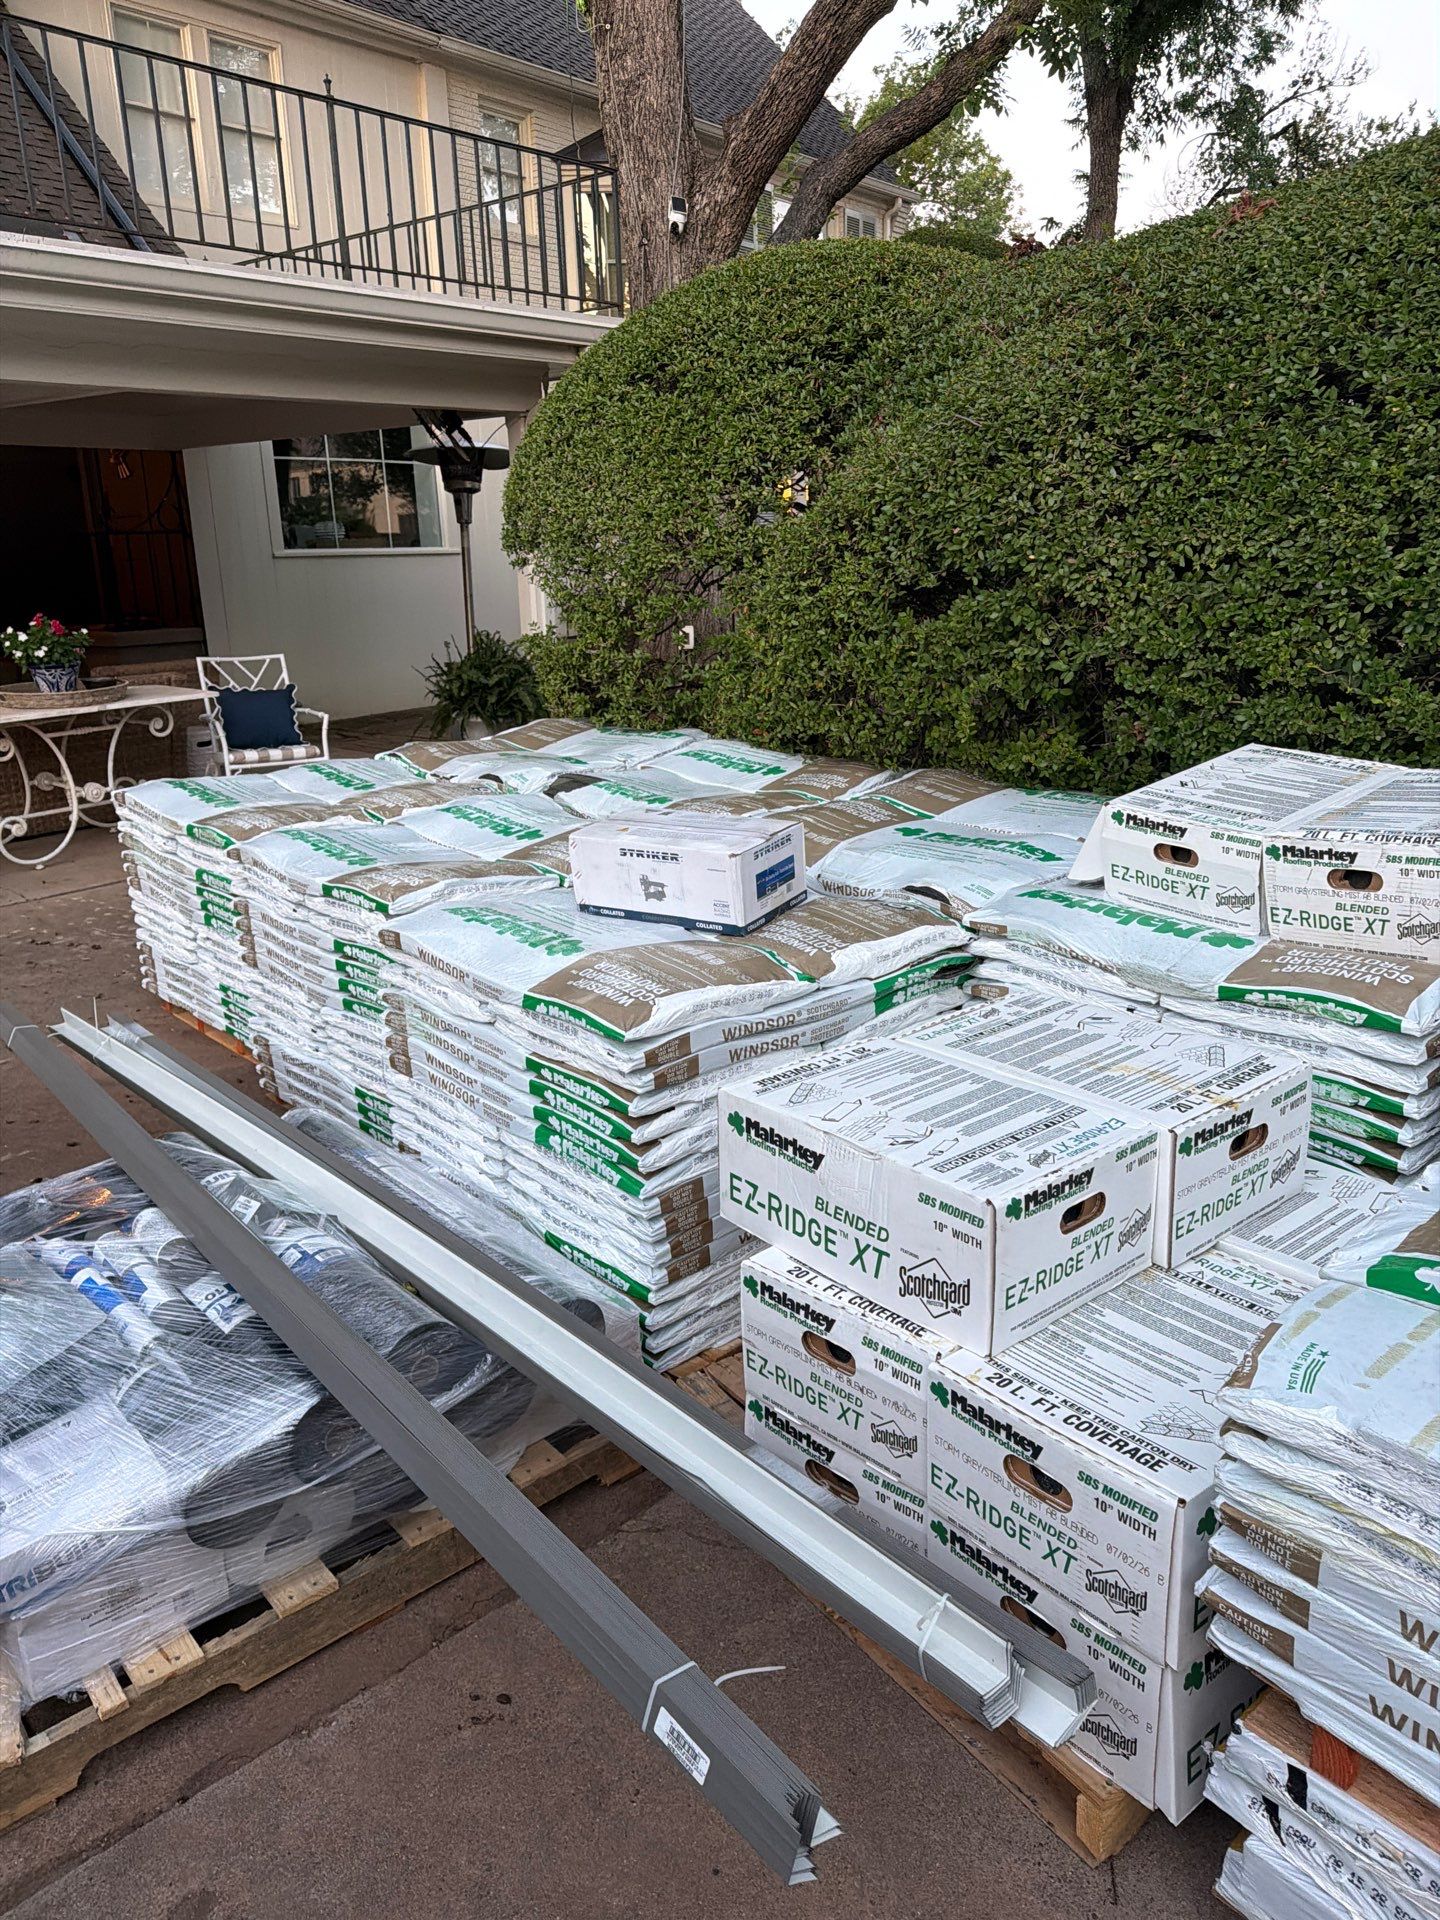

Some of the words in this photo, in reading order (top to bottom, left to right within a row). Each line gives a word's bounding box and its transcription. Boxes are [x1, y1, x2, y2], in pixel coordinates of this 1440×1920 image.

[1126, 813, 1188, 837] Malarkey
[1210, 831, 1225, 841] SBS
[1226, 834, 1262, 848] MODIFIED
[619, 848, 679, 862] STRIKER
[753, 833, 792, 861] STRIKER
[1236, 849, 1260, 861] WIDTH
[1282, 845, 1358, 864] Malarkey
[1385, 855, 1402, 863] SBS
[1165, 867, 1210, 884] BLENDED
[1283, 858, 1312, 867] Roofing
[1186, 884, 1210, 901] XT
[600, 908, 625, 917] COLLATED
[1335, 902, 1389, 915] BLENDED
[695, 922, 723, 931] COLLATED
[1363, 917, 1390, 936] XT
[810, 1026, 844, 1043] PROTECTOR
[554, 1072, 610, 1107] Malarkey
[753, 1063, 820, 1088] COVERAGE
[1171, 1104, 1193, 1113] 20
[1216, 1062, 1276, 1090] COVERAGE
[1271, 1095, 1283, 1108] SBS
[1284, 1081, 1308, 1099] MODIFIED
[1290, 1094, 1307, 1111] WIDTH
[557, 1094, 613, 1136] Malarkey
[1013, 1107, 1086, 1142] INSTALLATION
[1194, 1108, 1254, 1147] Malarkey
[561, 1122, 619, 1163] Malarkey
[746, 1118, 825, 1170] Malarkey
[746, 1135, 776, 1157] Roofing
[933, 1137, 1015, 1173] INSTRUCTIONS
[1115, 1150, 1128, 1163] SBS
[1129, 1133, 1158, 1157] MODIFIED
[1194, 1138, 1219, 1156] Roofing
[561, 1141, 621, 1187] Malarkey
[1138, 1149, 1157, 1167] WIDTH
[1231, 1158, 1269, 1186] BLENDED
[1024, 1167, 1094, 1209] Malarkey
[1247, 1172, 1268, 1200] XT
[815, 1196, 890, 1242] BLENDED
[918, 1192, 937, 1208] SBS
[939, 1200, 984, 1229] MODIFIED
[1024, 1200, 1053, 1220] Roofing
[952, 1228, 982, 1249] WIDTH
[1071, 1217, 1114, 1249] BLENDED
[1090, 1231, 1114, 1265] XT
[574, 1250, 630, 1292] Malarkey
[787, 1266, 804, 1279] 20
[849, 1238, 890, 1279] XT
[899, 1265, 970, 1310] Scotchgard
[1235, 1266, 1279, 1285] BLENDED
[1244, 1279, 1274, 1291] XT
[760, 1281, 836, 1333] Malarkey
[760, 1297, 787, 1318] Roofing
[861, 1335, 879, 1353] SBS
[881, 1345, 923, 1375] MODIFIED
[1299, 1341, 1319, 1363] MADE
[810, 1372, 863, 1408] BLENDED
[891, 1367, 921, 1391] WIDTH
[1286, 1373, 1299, 1391] USA
[837, 1401, 864, 1431] XT
[950, 1389, 1044, 1460] Malarkey
[951, 1408, 986, 1438] Roofing
[985, 1372, 1010, 1390] 20
[1010, 1387, 1026, 1400] L.
[1031, 1396, 1056, 1419] FT.
[1062, 1415, 1169, 1473] COVERAGE
[988, 1357, 1010, 1376] THIS
[1010, 1369, 1038, 1392] SIDE
[1037, 1384, 1054, 1398] UP
[1061, 1399, 1092, 1420] KEEP
[1090, 1412, 1119, 1432] THIS
[1120, 1427, 1169, 1457] CARTON
[1166, 1454, 1198, 1473] DRY
[764, 1408, 835, 1464] Malarkey
[765, 1422, 791, 1445] Roofing
[862, 1469, 880, 1485] SBS
[882, 1478, 925, 1509] MODIFIED
[934, 1435, 960, 1456] STORM
[1023, 1491, 1042, 1512] MIST
[1060, 1511, 1098, 1546] BLENDED
[1077, 1470, 1099, 1491] SBS
[1102, 1484, 1159, 1523] MODIFIED
[893, 1500, 924, 1524] WIDTH
[1010, 1499, 1078, 1551] BLENDED
[1118, 1508, 1157, 1542] WIDTH
[1042, 1540, 1078, 1576] XT
[1247, 1529, 1261, 1541] DO
[1268, 1540, 1292, 1559] NOT
[950, 1547, 984, 1576] Roofing
[950, 1531, 1038, 1604] Malarkey
[1085, 1568, 1147, 1612] Scotchgard
[1219, 1603, 1273, 1639] CAUTION:
[1070, 1618, 1092, 1638] SBS
[1094, 1630, 1146, 1676] MODIFIED
[1109, 1657, 1146, 1693] WIDTH
